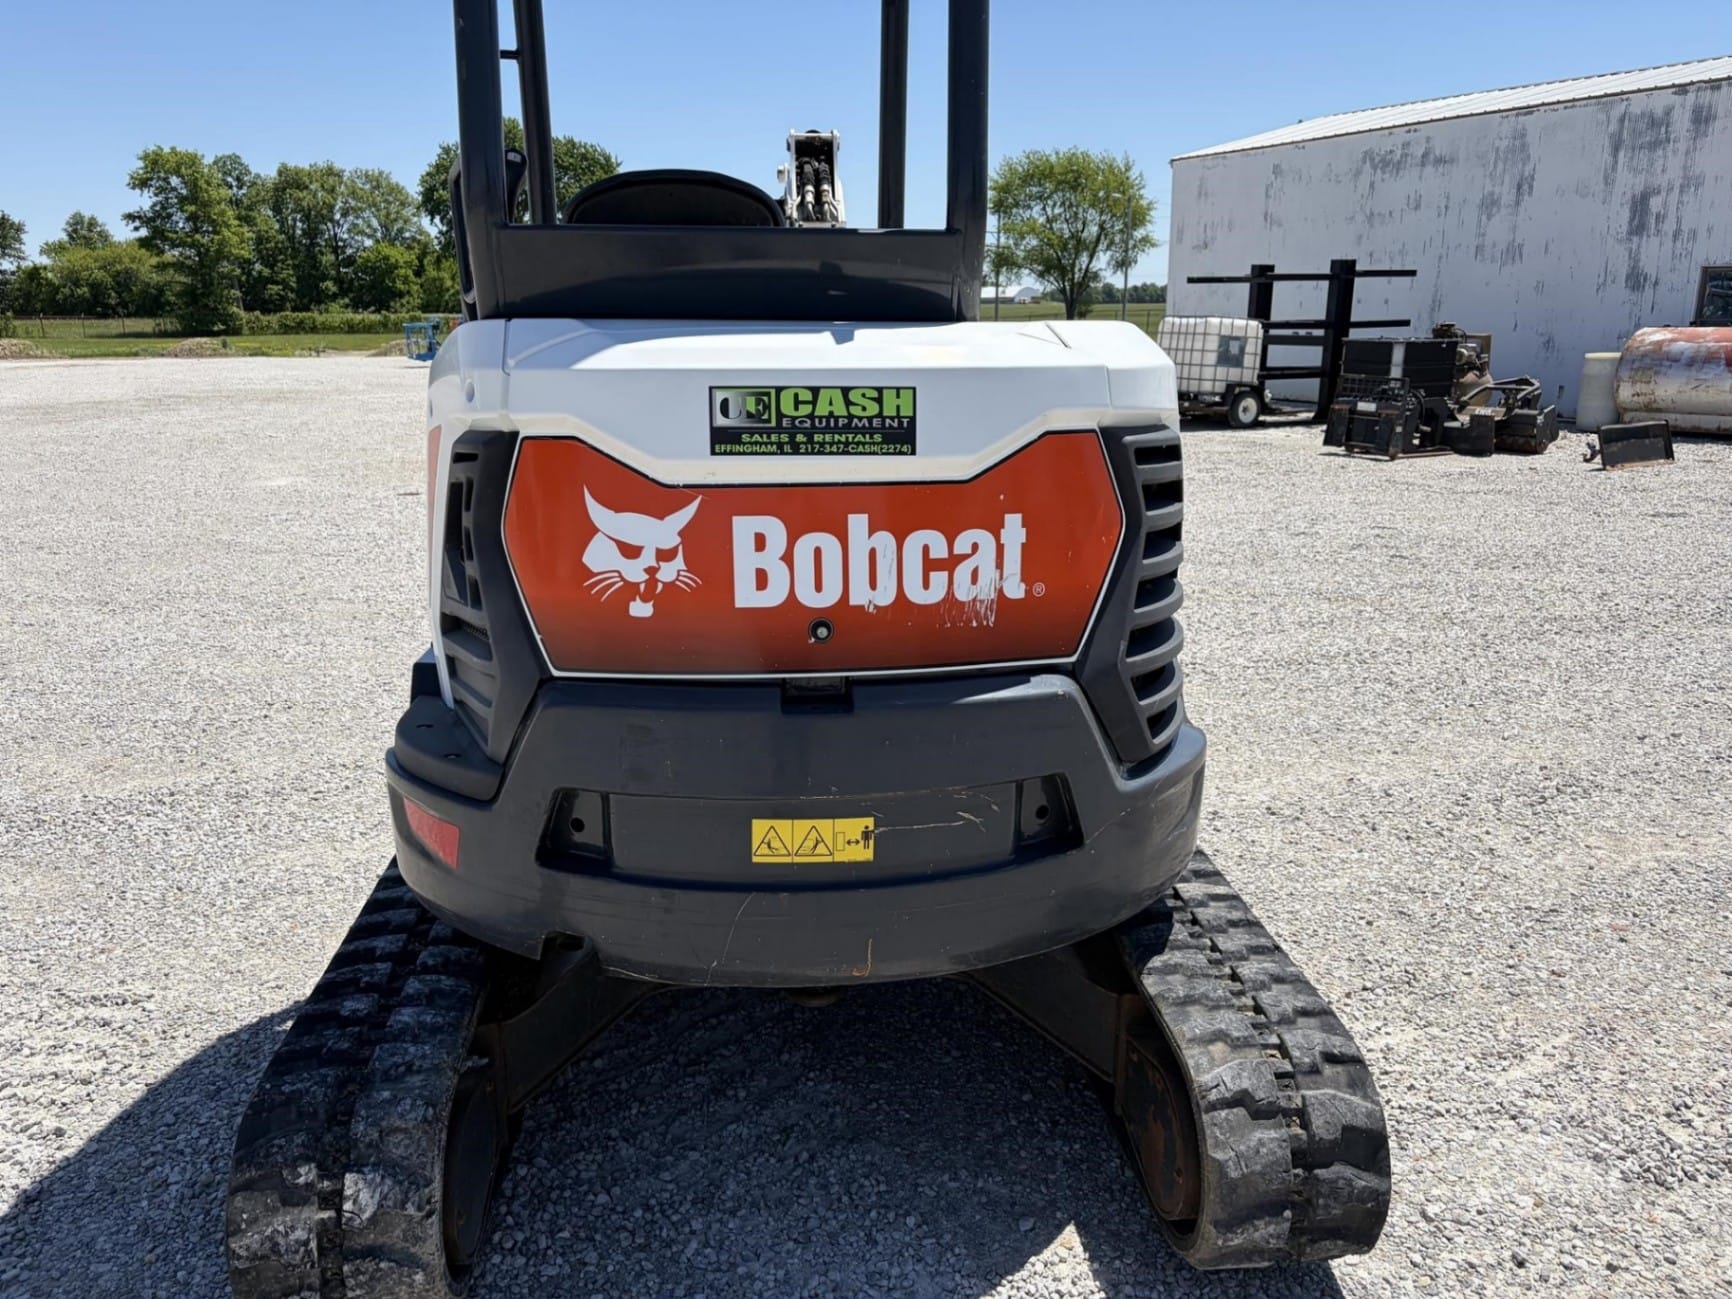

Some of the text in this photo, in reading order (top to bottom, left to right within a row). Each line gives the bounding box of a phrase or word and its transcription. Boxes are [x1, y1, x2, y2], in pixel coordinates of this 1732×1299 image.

[780, 387, 914, 417] CASH
[782, 417, 910, 428] EQUIPMENT
[741, 433, 883, 443] SALES & RENTALS
[714, 443, 912, 455] EFFINGHAM, IL 217-347-CASH(2274)
[731, 512, 1027, 609] Bobcat
